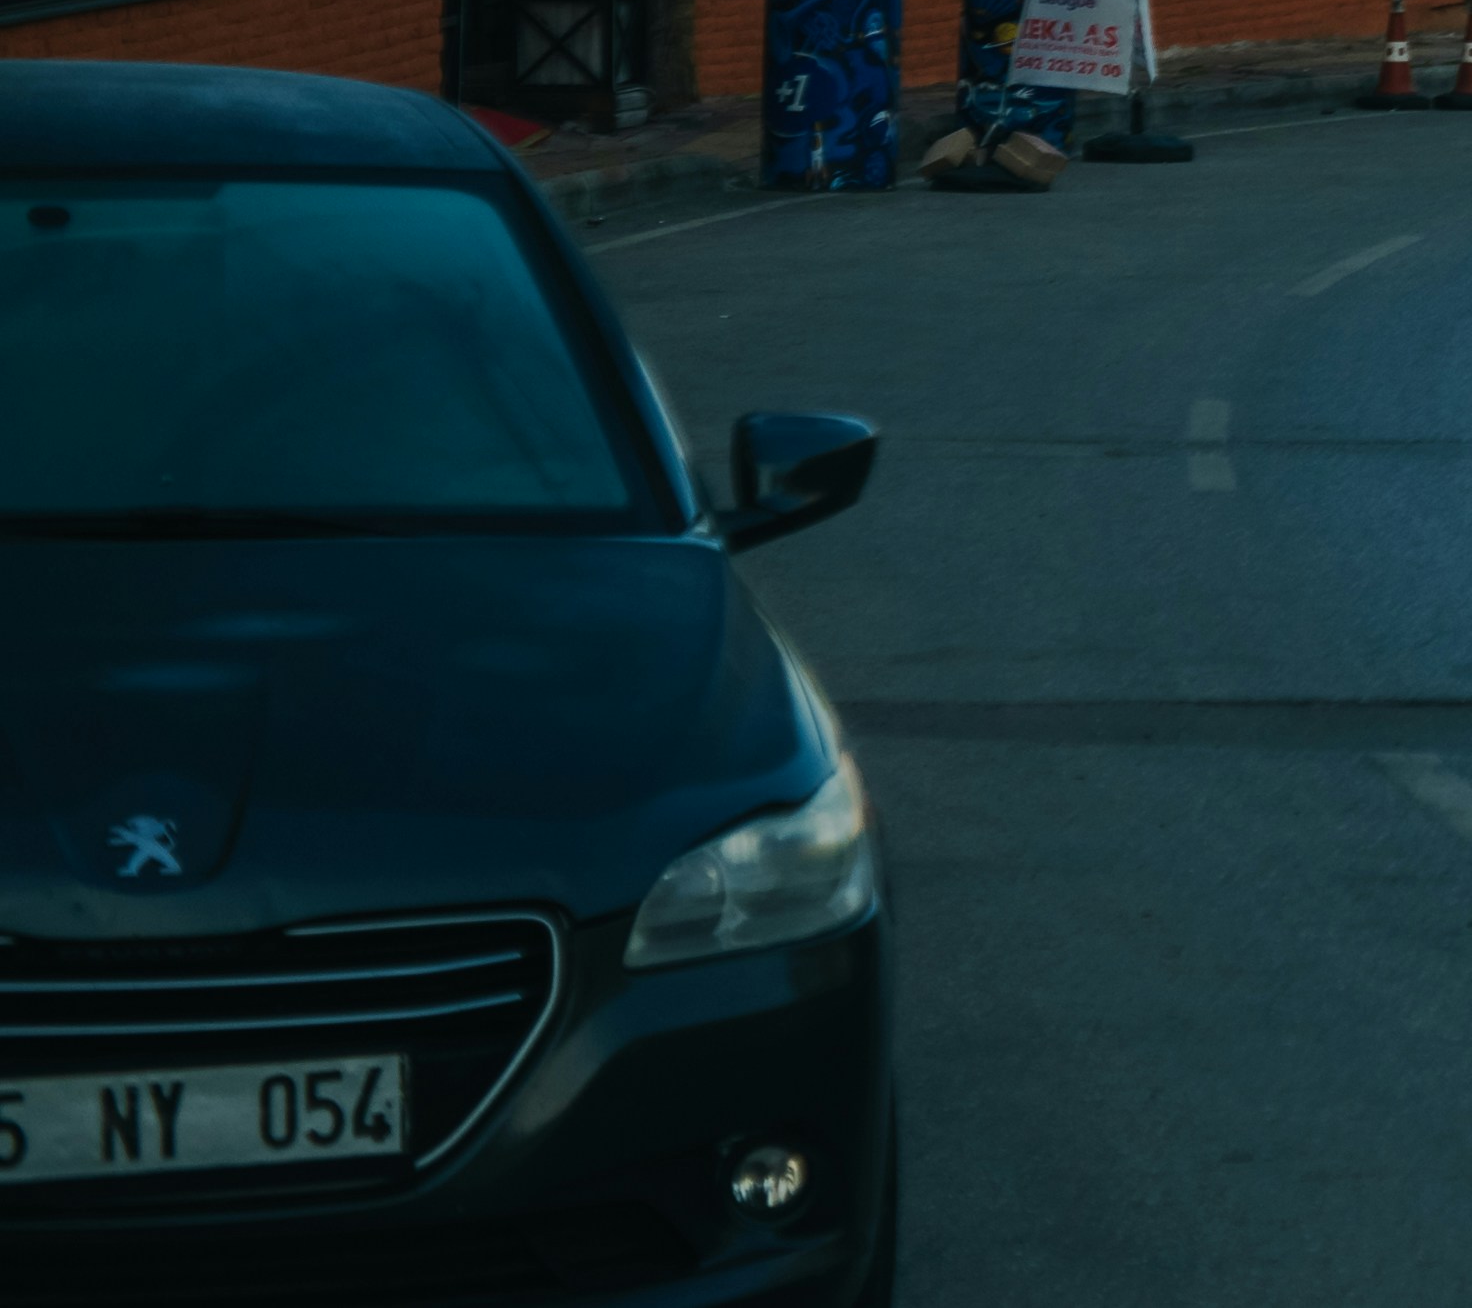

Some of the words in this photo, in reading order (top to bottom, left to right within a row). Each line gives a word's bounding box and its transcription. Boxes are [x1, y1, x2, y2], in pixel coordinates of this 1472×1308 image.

[775, 74, 811, 112] +1
[102, 1082, 184, 1162] NY
[259, 1067, 392, 1150] 054
